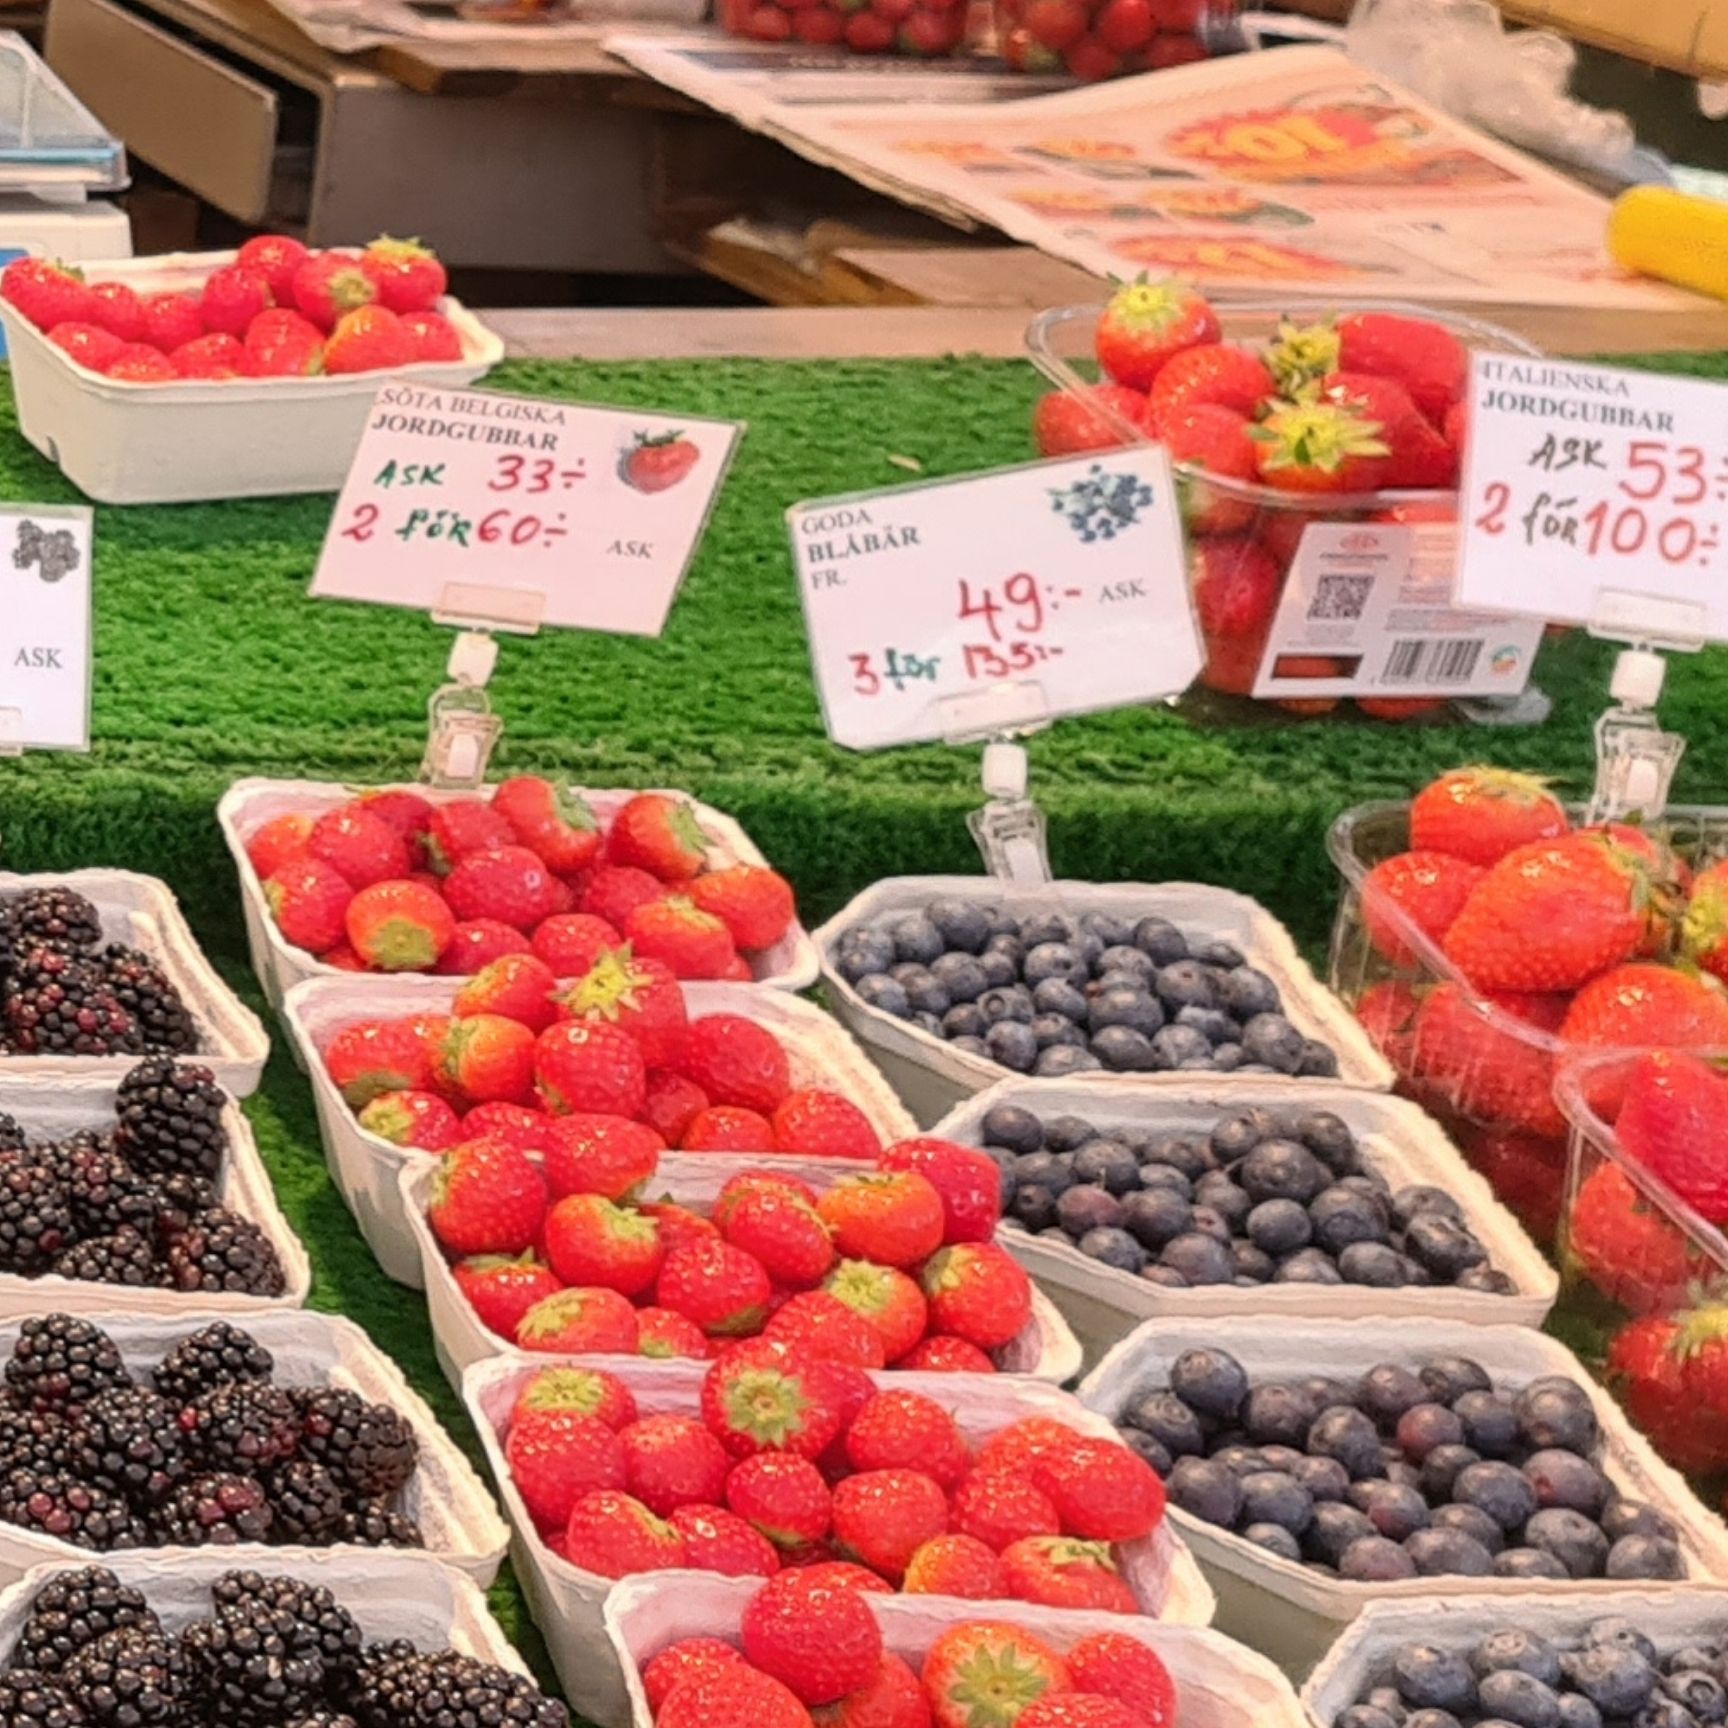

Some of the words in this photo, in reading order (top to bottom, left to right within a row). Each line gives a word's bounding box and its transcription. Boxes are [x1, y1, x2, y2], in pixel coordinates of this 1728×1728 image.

[1482, 360, 1631, 397] ITALIENSKA
[378, 387, 443, 413] SÖTA
[449, 398, 568, 428] BELGISKA
[1480, 389, 1676, 434] JORDGUBBAR
[371, 412, 560, 453] JORDGUBBAR
[1528, 432, 1608, 472] ASK
[373, 459, 447, 488] ASK
[341, 503, 380, 542] 2
[801, 507, 873, 536] GODA
[1475, 482, 1511, 535] 2
[606, 538, 655, 559] ASK
[806, 524, 921, 565] BLÅBÄR
[810, 568, 848, 590] FR.
[958, 572, 1082, 642] 49:-
[1098, 579, 1148, 604] ASK
[14, 647, 64, 669] ASK
[848, 652, 880, 697] 3
